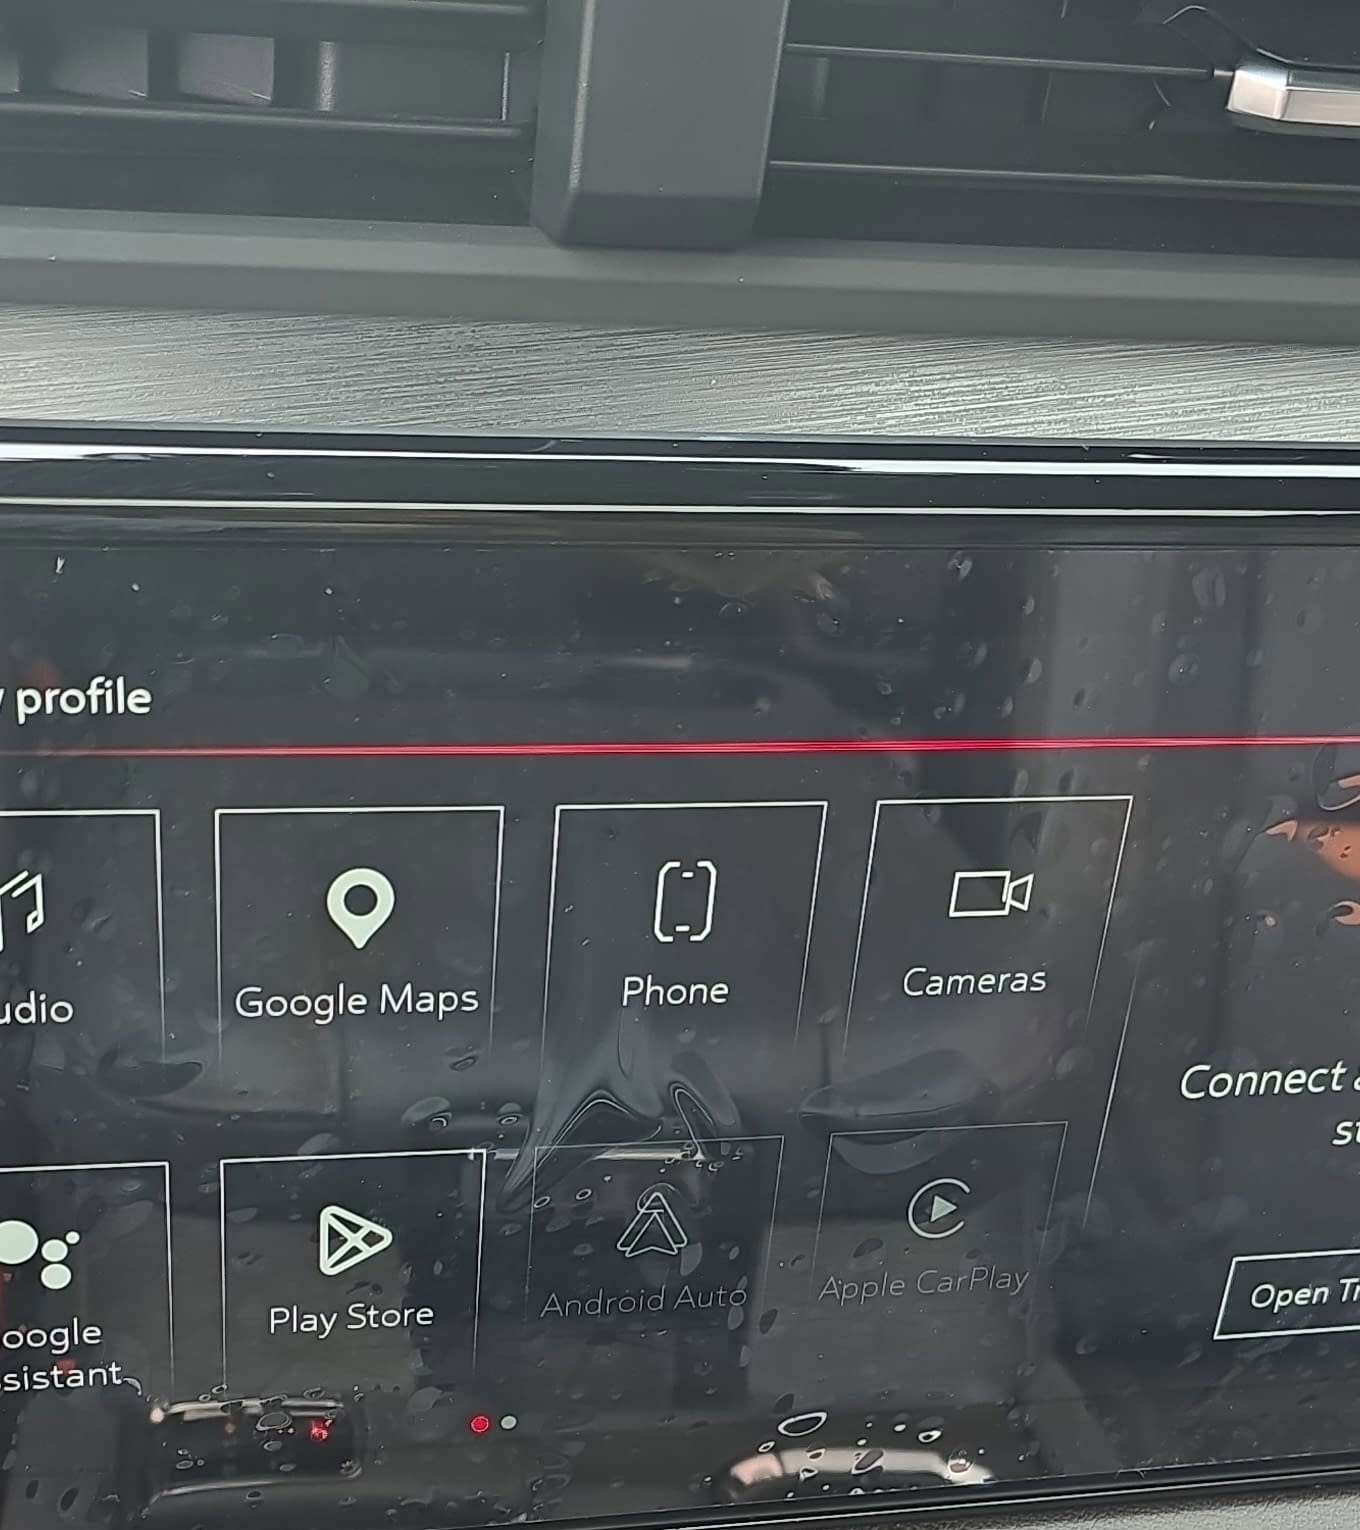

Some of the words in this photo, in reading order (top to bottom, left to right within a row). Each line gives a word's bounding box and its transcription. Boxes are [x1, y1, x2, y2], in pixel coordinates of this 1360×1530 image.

[16, 676, 152, 725] profile
[622, 974, 729, 1006] Phone
[903, 967, 1046, 996] Cameras
[235, 982, 368, 1025] Google
[380, 982, 479, 1021] Maps
[1181, 1060, 1348, 1099] Connect
[540, 1283, 666, 1318] Android
[673, 1279, 747, 1310] Auto
[818, 1271, 905, 1307] Apple
[917, 1264, 1030, 1296] CarPlay
[1251, 1283, 1330, 1313] Open
[270, 1304, 338, 1339] Play
[347, 1303, 434, 1329] Store
